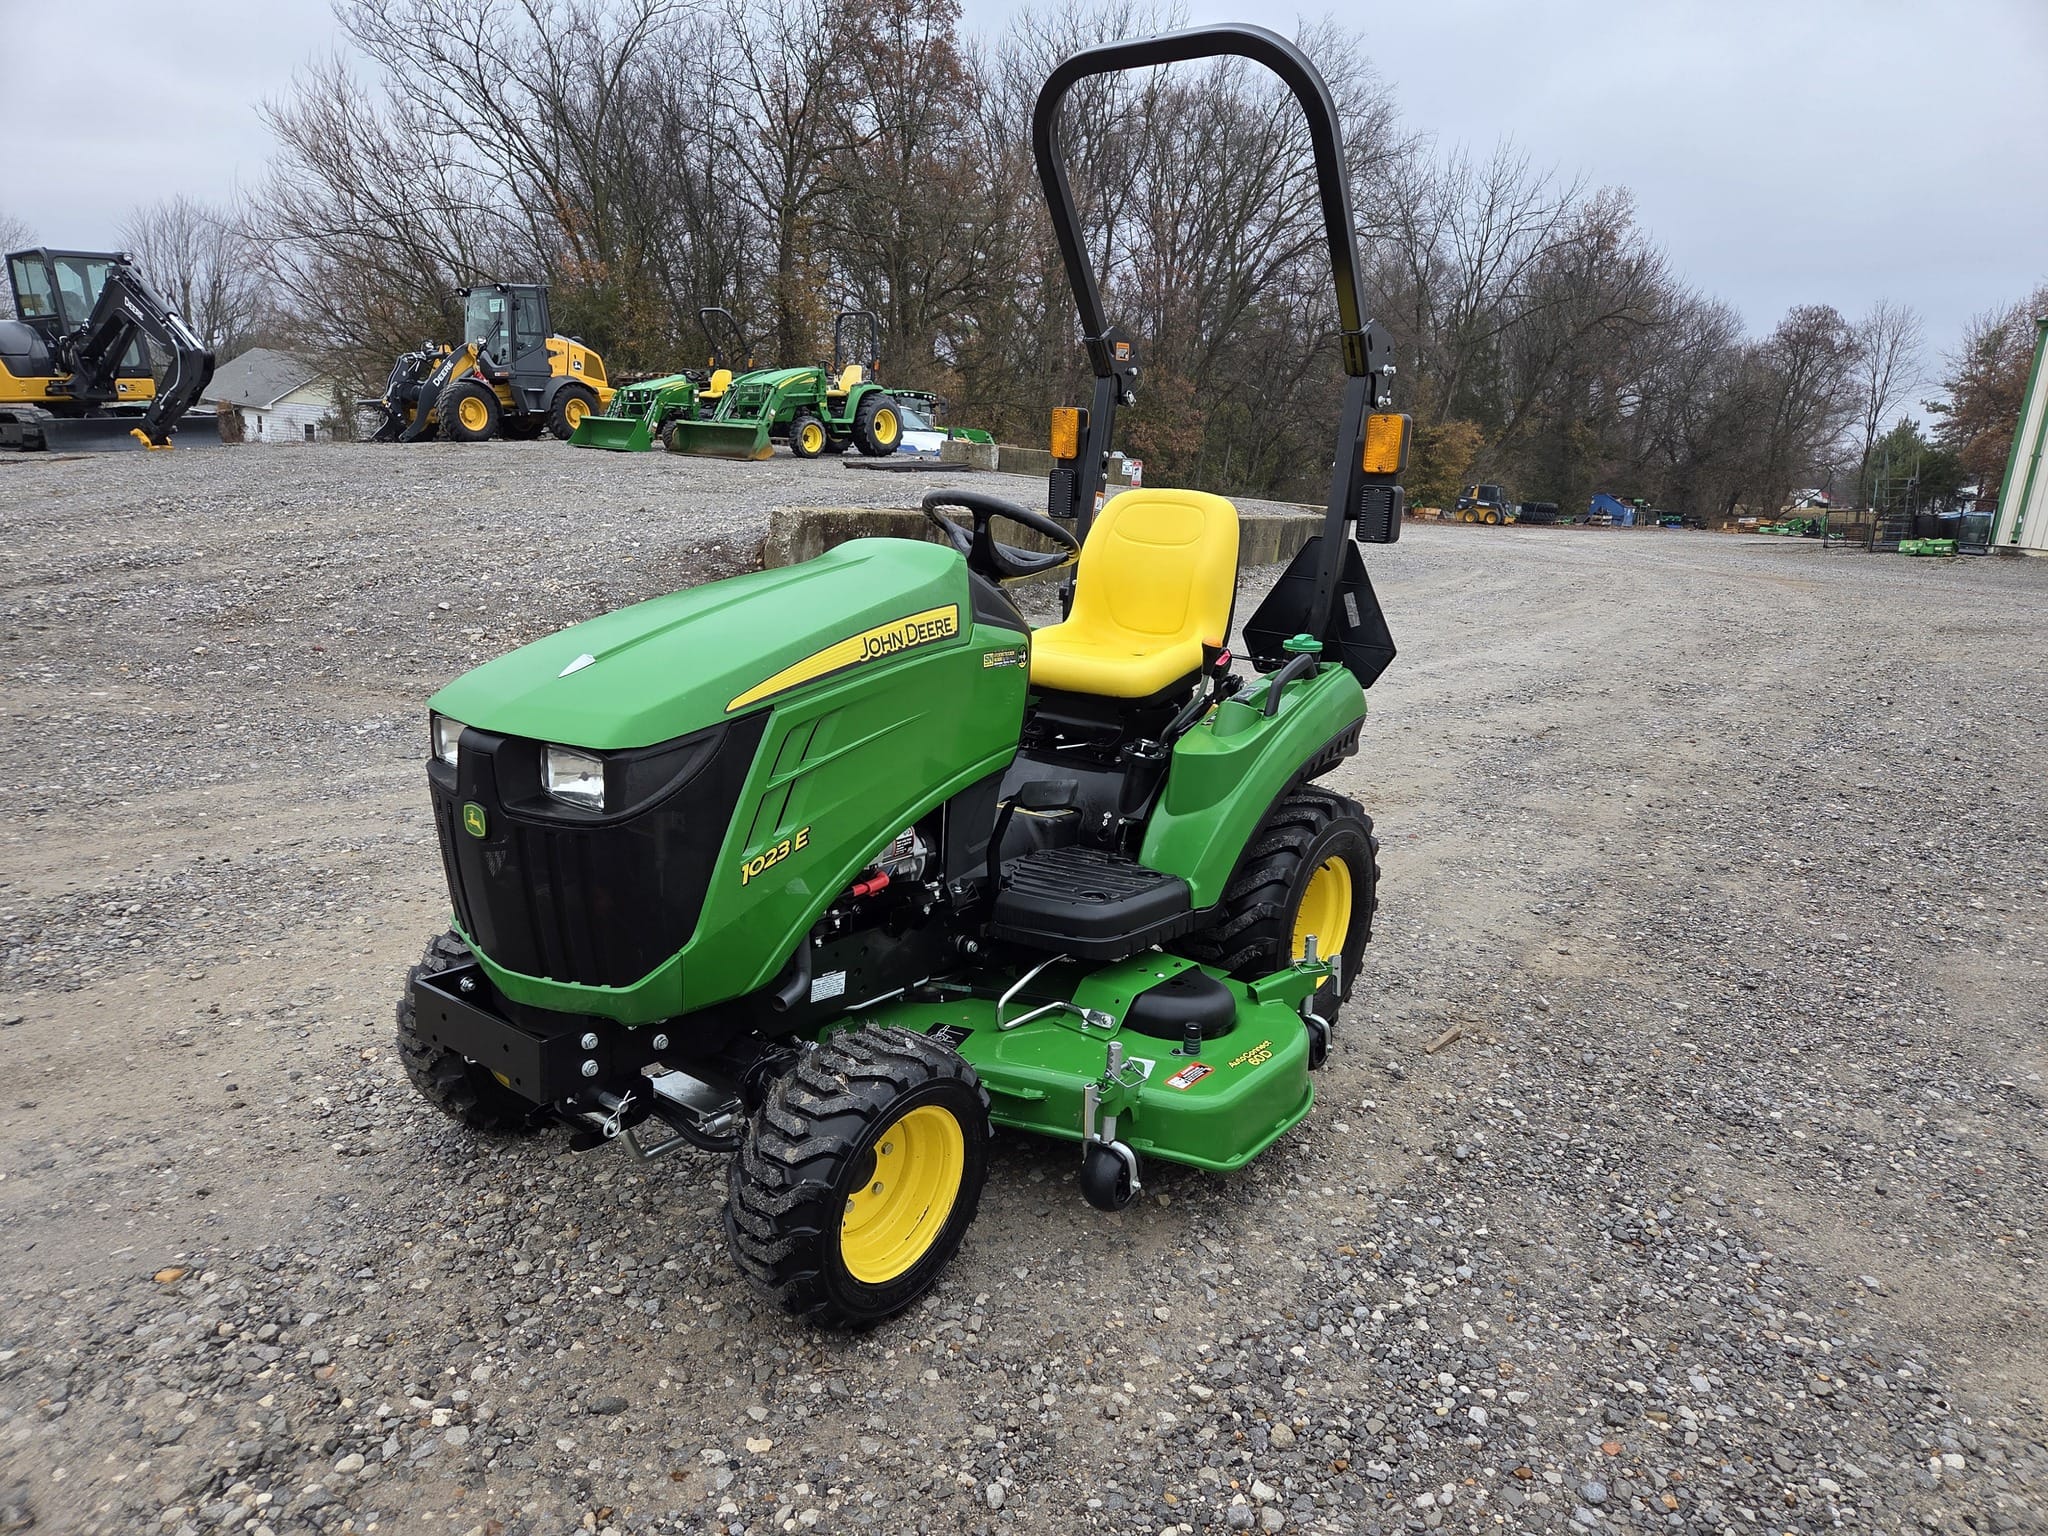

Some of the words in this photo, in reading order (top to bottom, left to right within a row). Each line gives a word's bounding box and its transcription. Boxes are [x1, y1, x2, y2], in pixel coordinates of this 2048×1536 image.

[432, 359, 454, 387] DEERE
[859, 629, 904, 659] JOHN
[905, 617, 953, 644] DEERE
[741, 839, 792, 887] 1023
[794, 826, 811, 851] E
[1247, 1050, 1272, 1066] 60D
